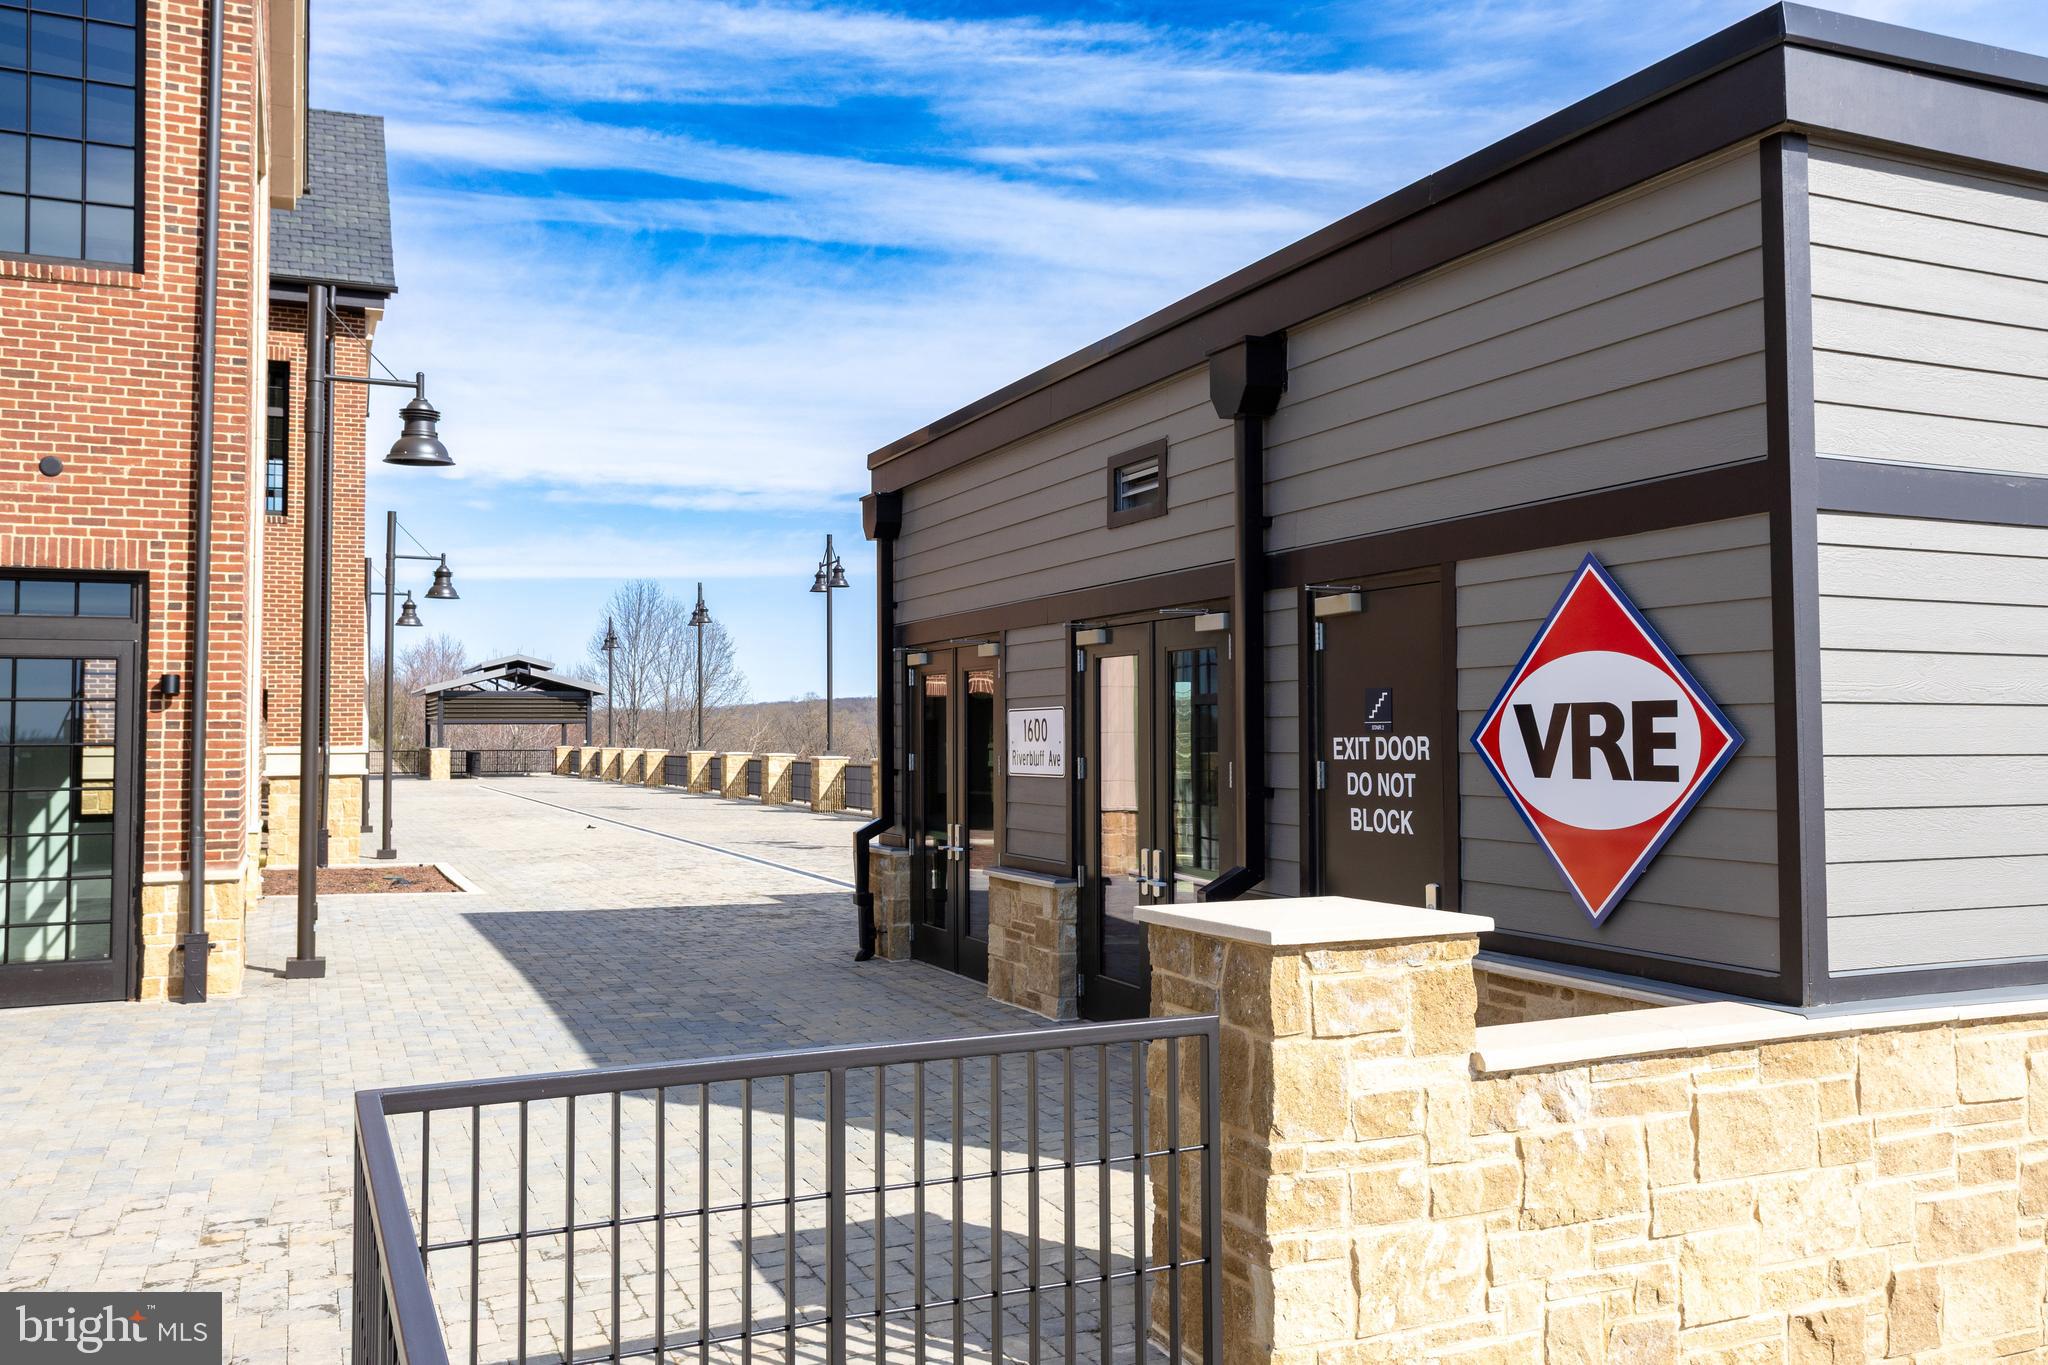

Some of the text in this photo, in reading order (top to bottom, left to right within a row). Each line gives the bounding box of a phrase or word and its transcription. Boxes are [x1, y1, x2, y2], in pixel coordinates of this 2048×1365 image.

[1023, 717, 1048, 742] 1600
[1513, 700, 1680, 783] VRE
[1011, 750, 1061, 767] Riverbluff Ave
[1333, 736, 1430, 761] EXIT DOOR
[1347, 772, 1416, 798] DO NOT
[1350, 807, 1414, 835] BLOCK
